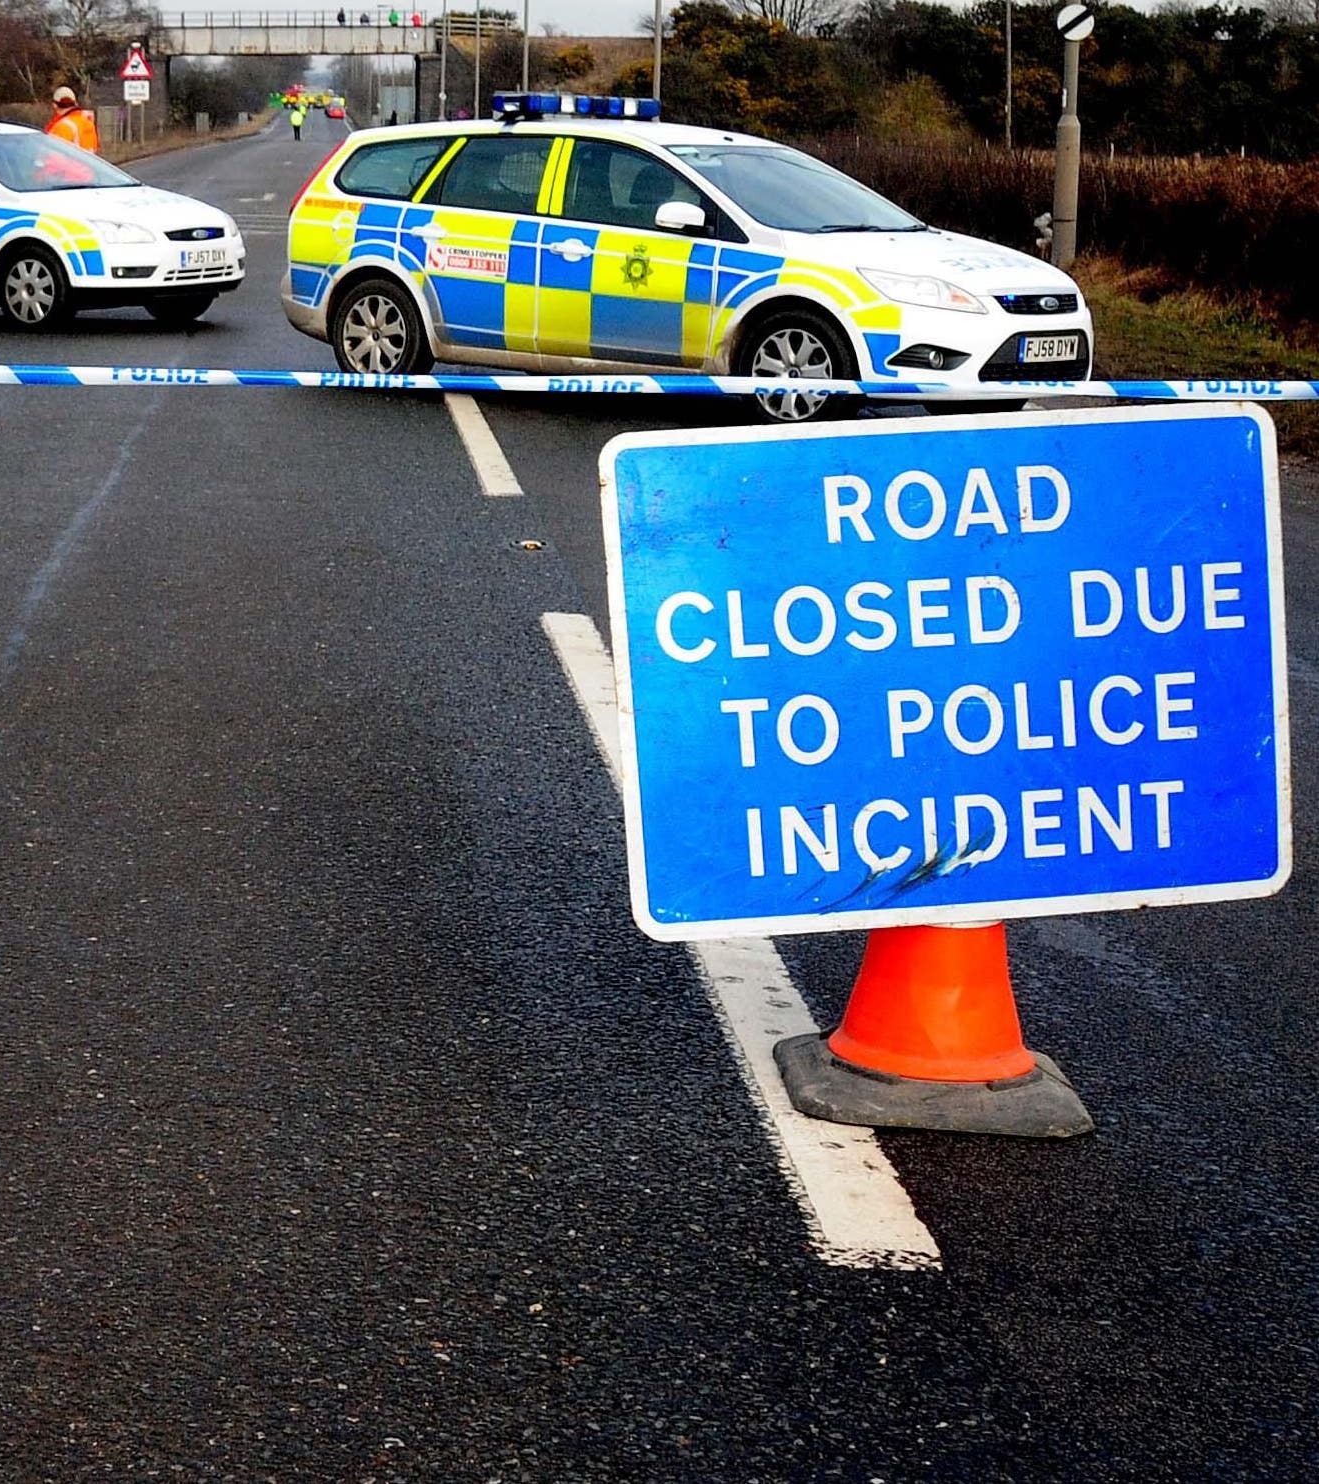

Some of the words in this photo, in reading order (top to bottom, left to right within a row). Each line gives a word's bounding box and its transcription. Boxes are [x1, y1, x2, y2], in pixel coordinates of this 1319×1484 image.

[187, 250, 210, 264] FJ57
[448, 247, 507, 260] CRIMESTOPPERS
[1026, 339, 1055, 358] FJ58
[823, 464, 1072, 544] ROAD
[655, 575, 1022, 663] CLOSED
[1070, 561, 1246, 639] DUE
[720, 694, 840, 768] TO
[887, 671, 1199, 759] POLICE
[746, 780, 1184, 877] INCIDENT
